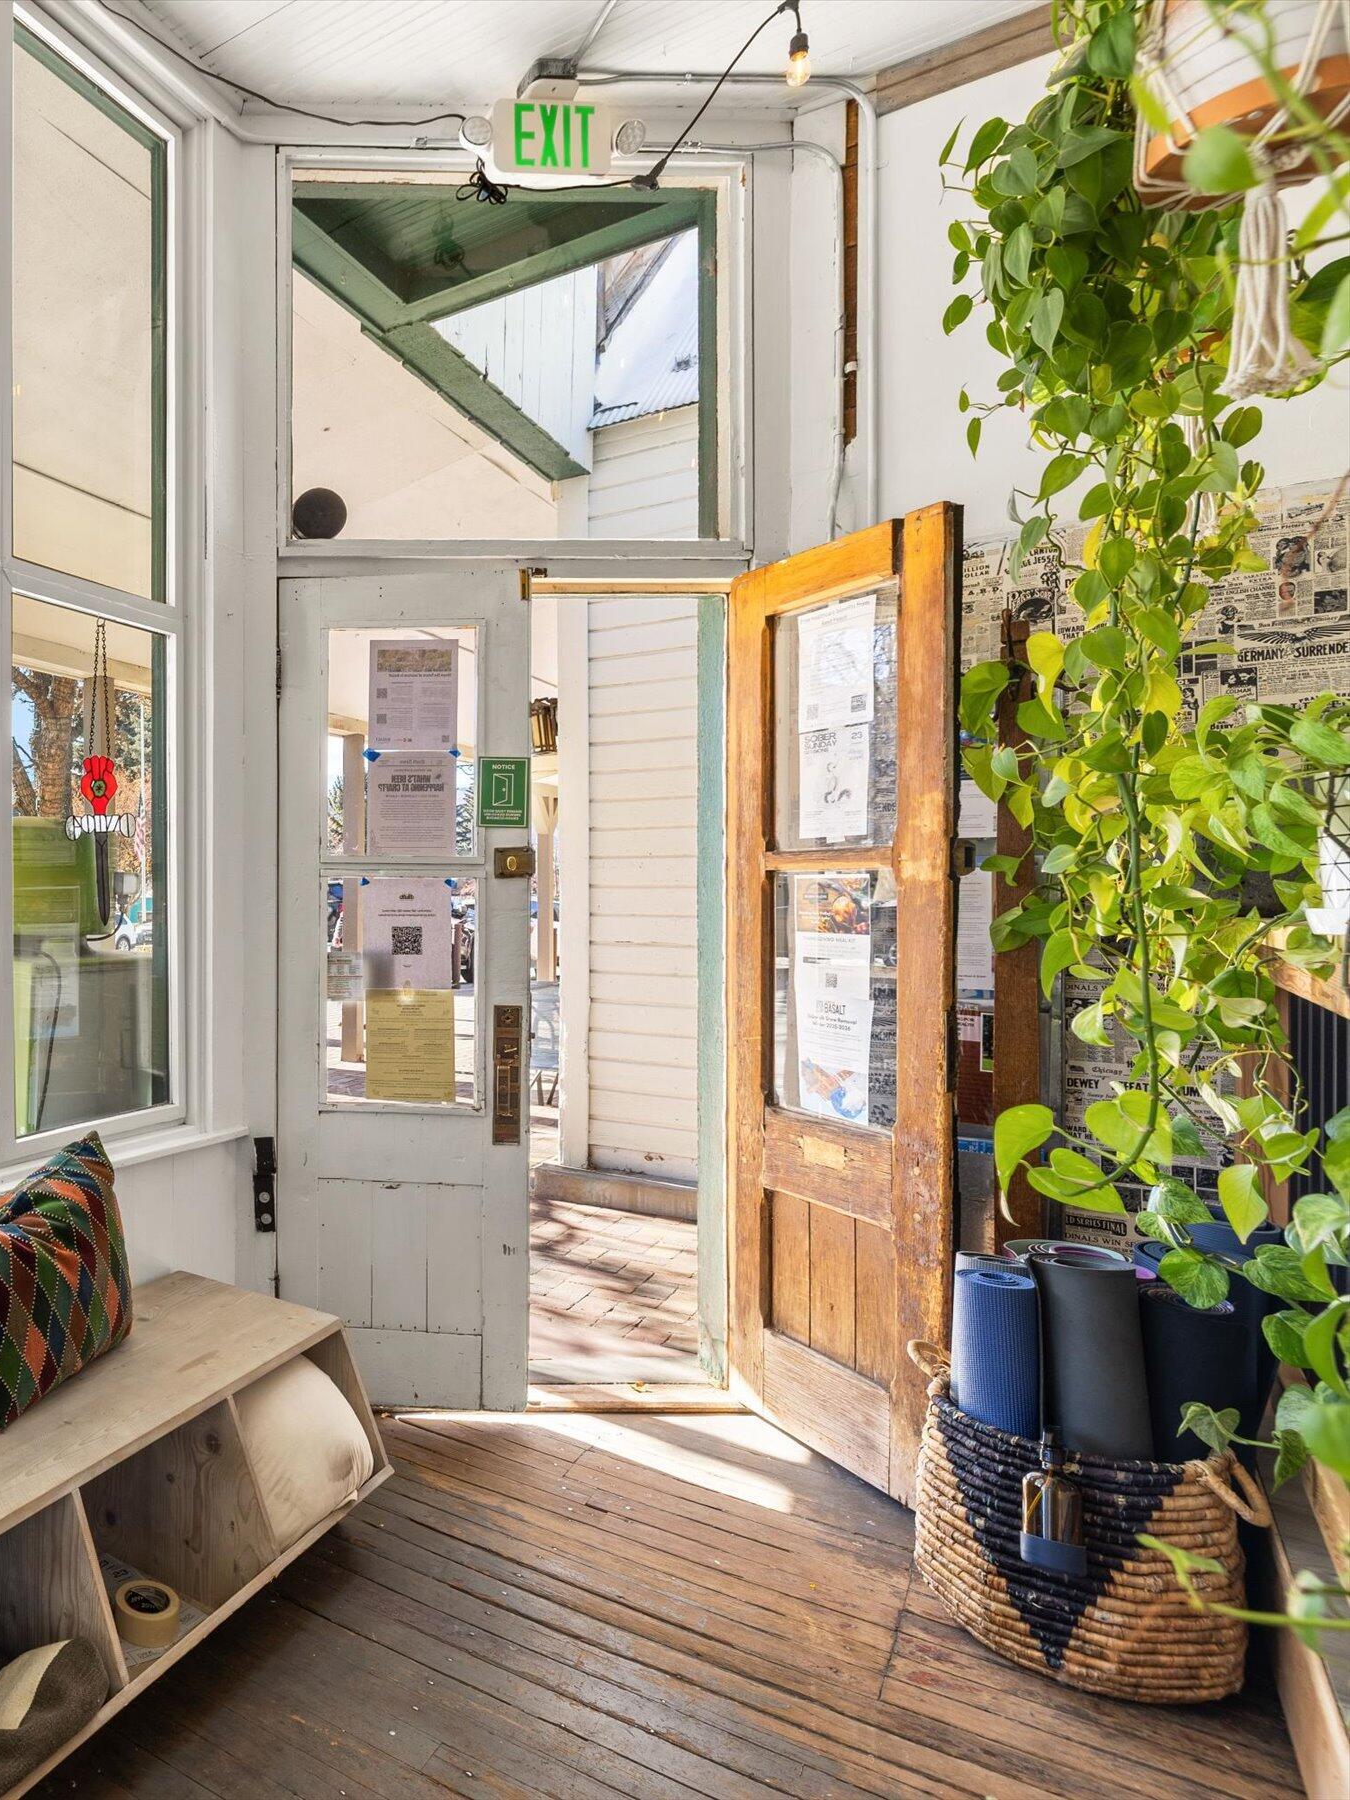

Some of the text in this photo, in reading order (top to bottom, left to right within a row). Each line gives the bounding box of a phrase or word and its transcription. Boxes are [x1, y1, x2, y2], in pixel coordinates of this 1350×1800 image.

[514, 103, 595, 168] EXIT
[1238, 648, 1285, 662] GERMANY
[851, 732, 863, 740] 23
[1066, 1077, 1100, 1089] DEWEY
[1076, 1217, 1101, 1228] SERIES
[1102, 1220, 1126, 1235] FINAL
[1101, 1237, 1121, 1246] WIN
